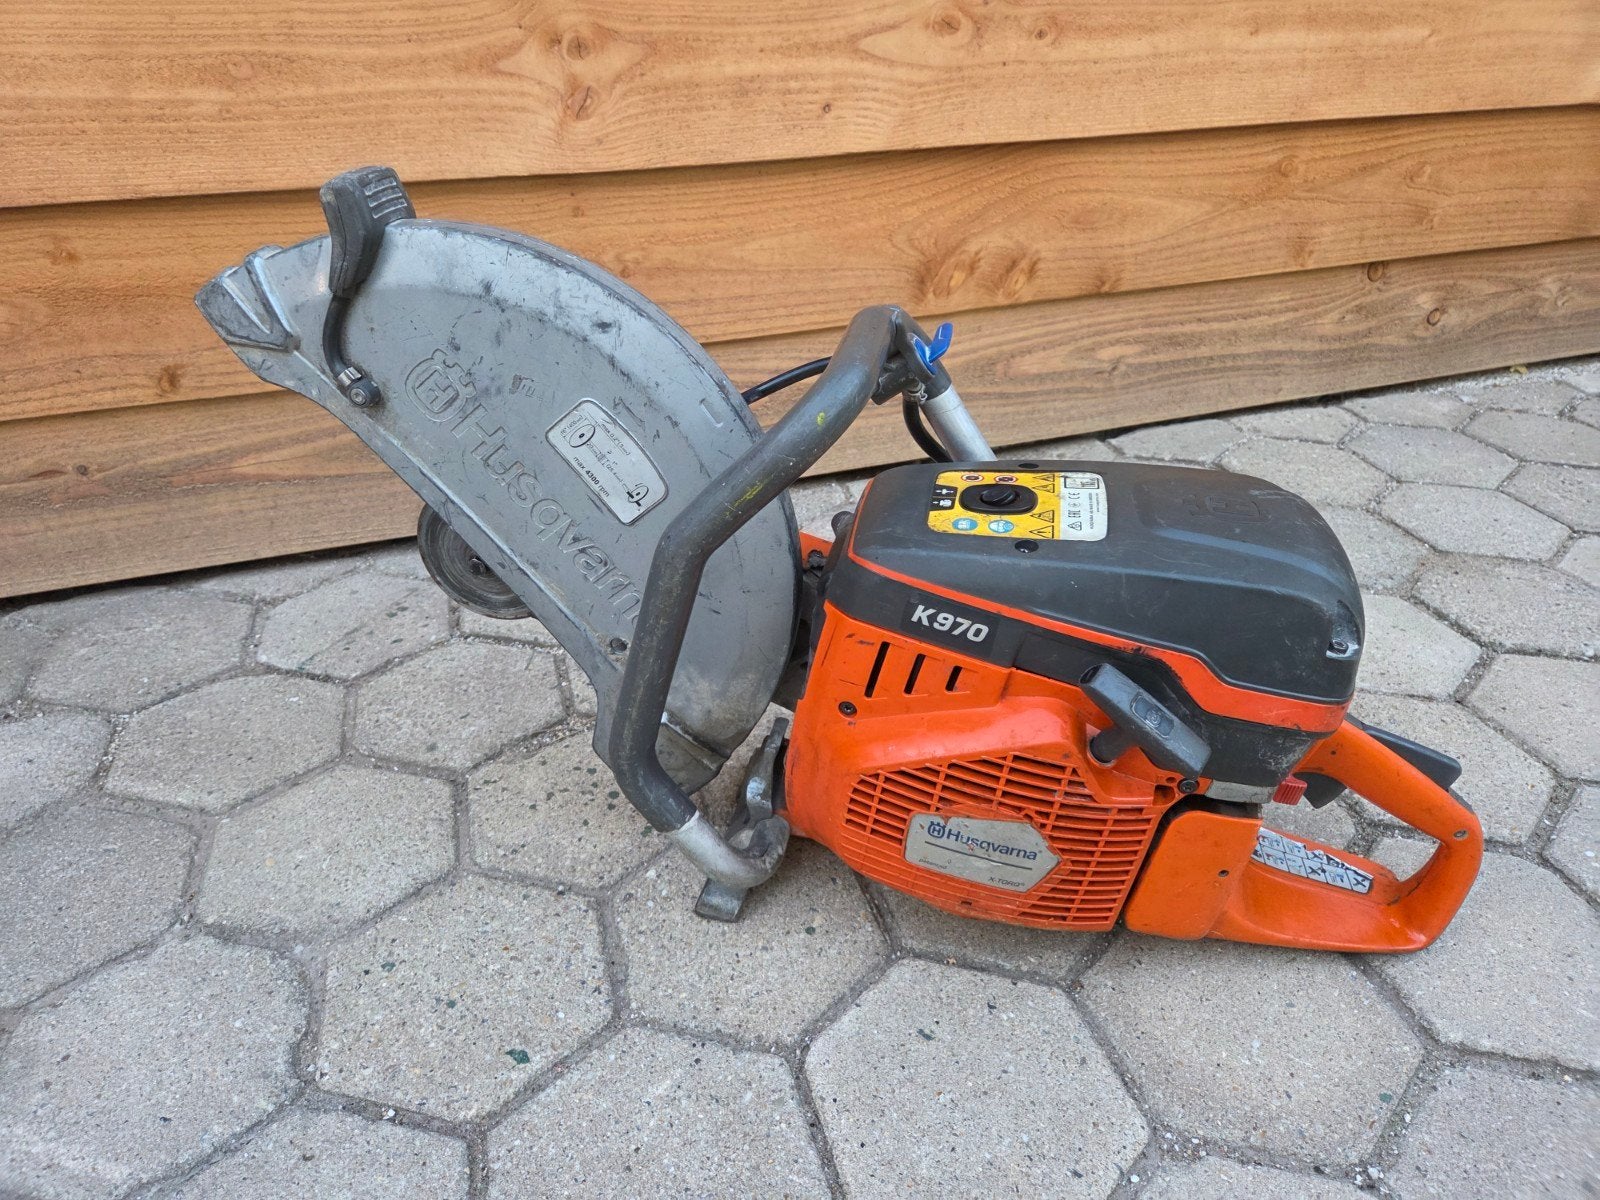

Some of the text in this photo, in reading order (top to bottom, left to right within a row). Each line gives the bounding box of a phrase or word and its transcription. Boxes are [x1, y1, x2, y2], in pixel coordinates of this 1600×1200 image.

[573, 456, 611, 498] max 4300 rpm
[451, 402, 644, 624] Husqvarn
[910, 604, 990, 643] K970
[946, 828, 1038, 861] Husqvarna
